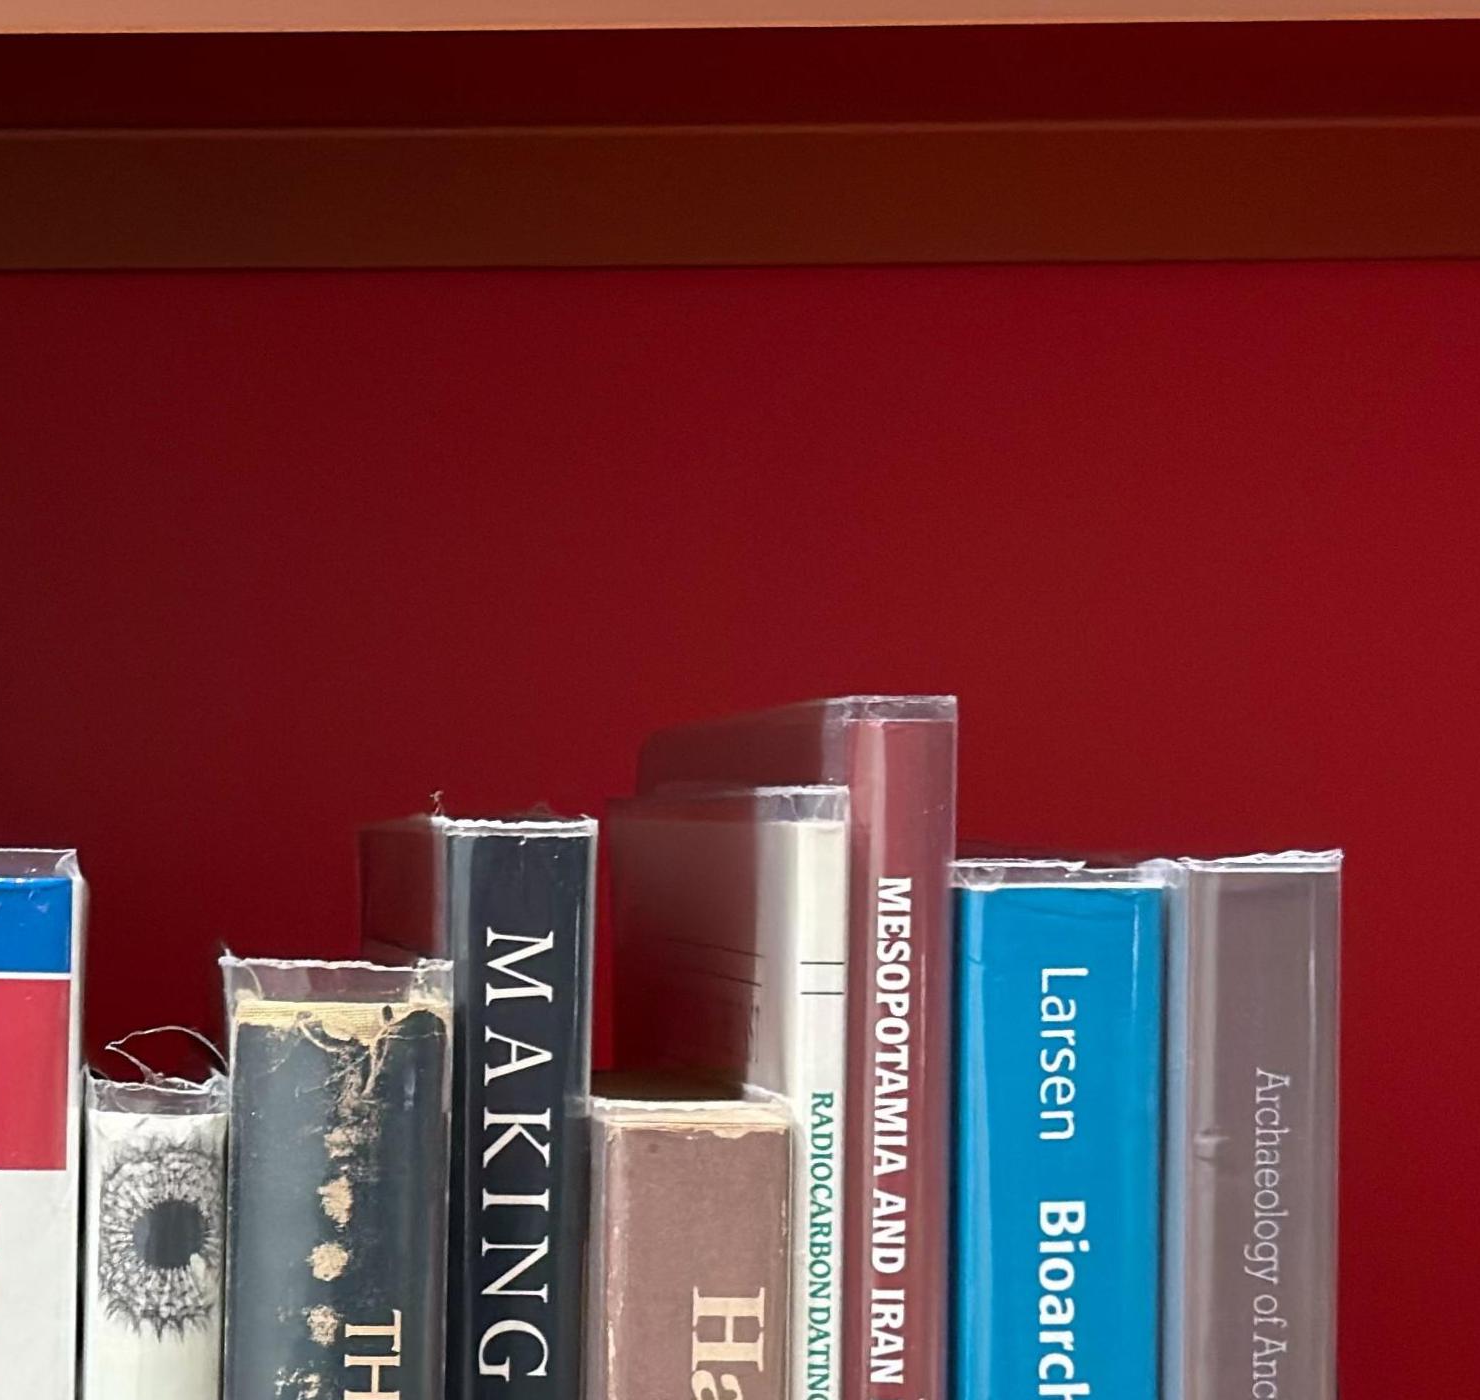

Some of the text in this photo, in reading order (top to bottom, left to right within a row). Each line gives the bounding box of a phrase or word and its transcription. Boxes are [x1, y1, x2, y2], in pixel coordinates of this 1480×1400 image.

[873, 876, 913, 1178] MESOPOTAMIA
[1040, 967, 1088, 1142] Larsen
[477, 927, 555, 1384] MAKING
[808, 1092, 836, 1301] RADIOCARBON
[872, 1188, 908, 1275] AND
[1244, 1067, 1280, 1285] Archaeology
[869, 1288, 904, 1389] IRAN
[1252, 1294, 1283, 1331] of
